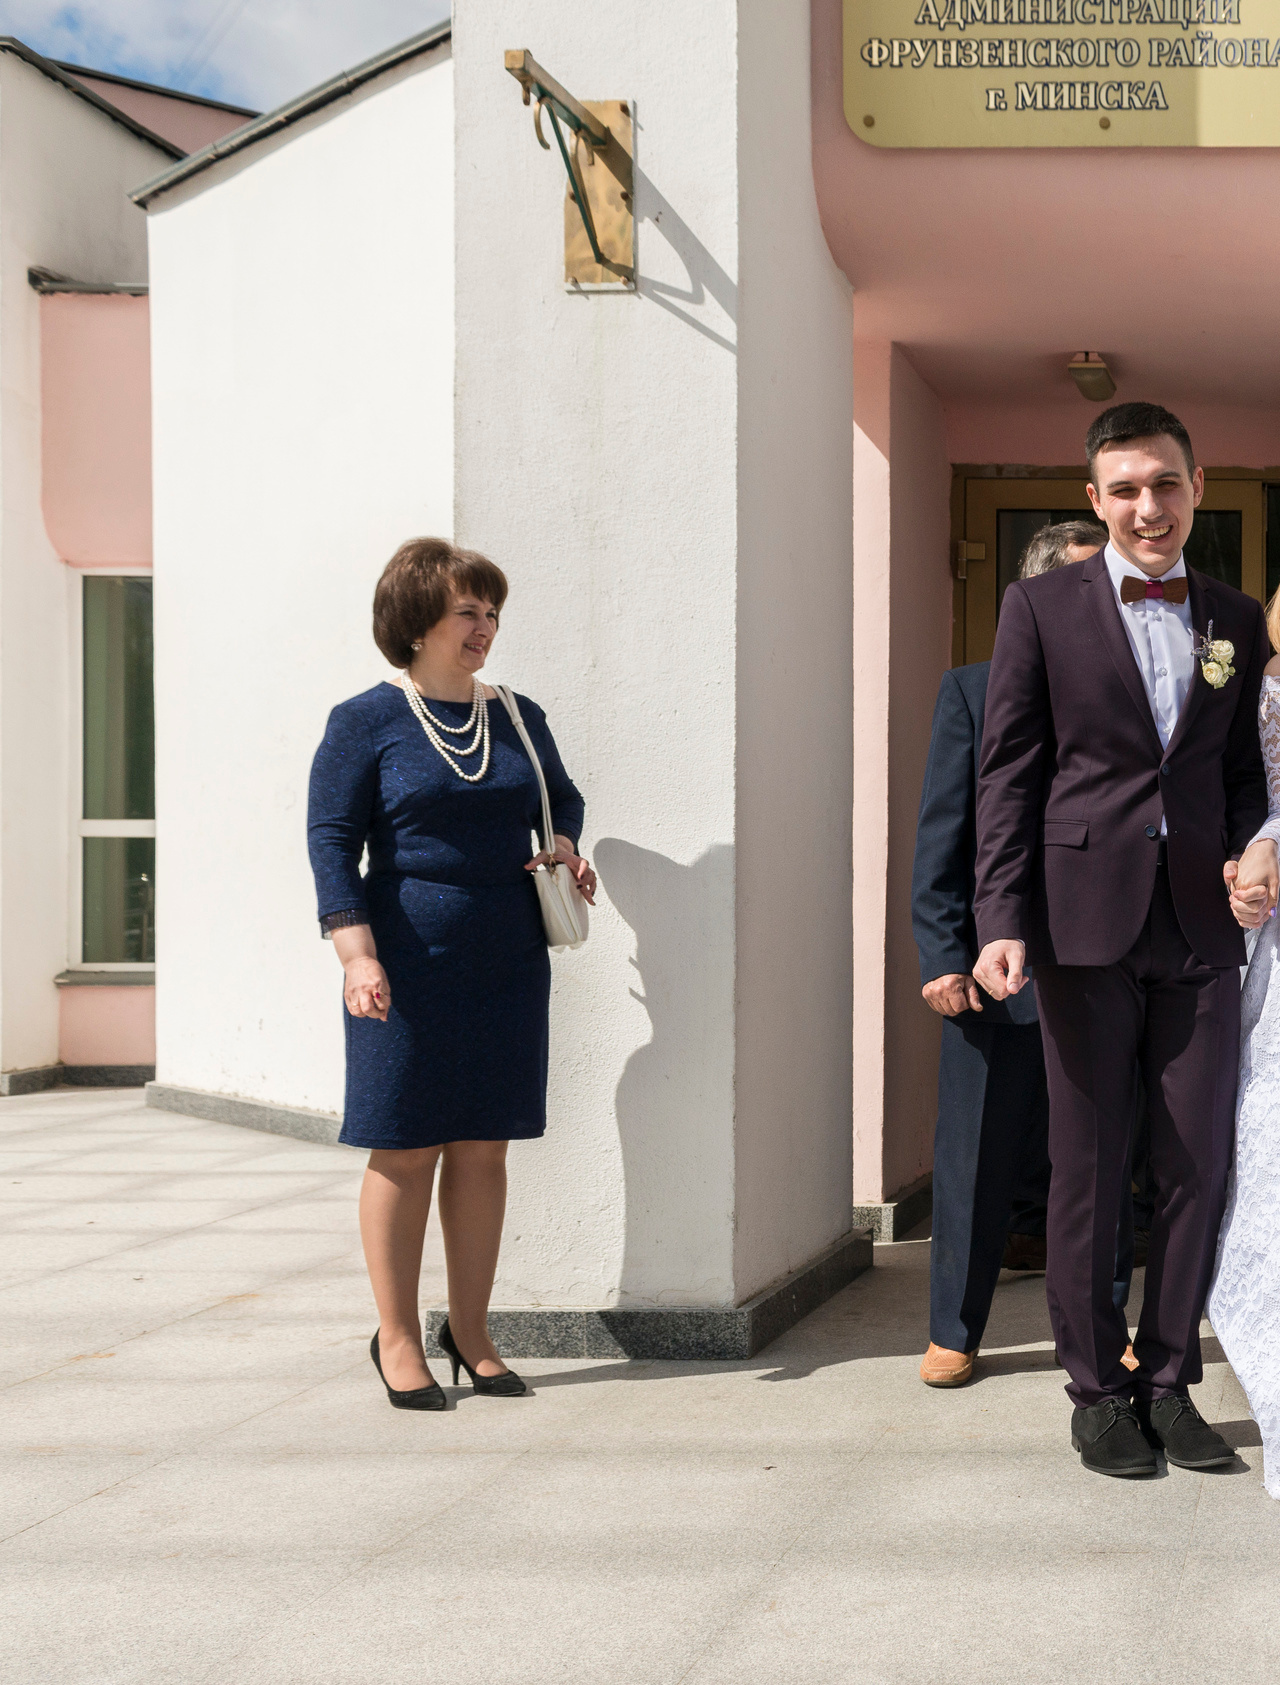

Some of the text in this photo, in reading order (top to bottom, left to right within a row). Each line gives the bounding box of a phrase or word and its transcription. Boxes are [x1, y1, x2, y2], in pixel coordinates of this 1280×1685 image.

[915, 0, 1241, 30] АДМИНИСТРАЦИИ
[861, 38, 1144, 67] ФРУНЗЕНСКОГО
[986, 81, 1168, 111] г. МИНСКА
